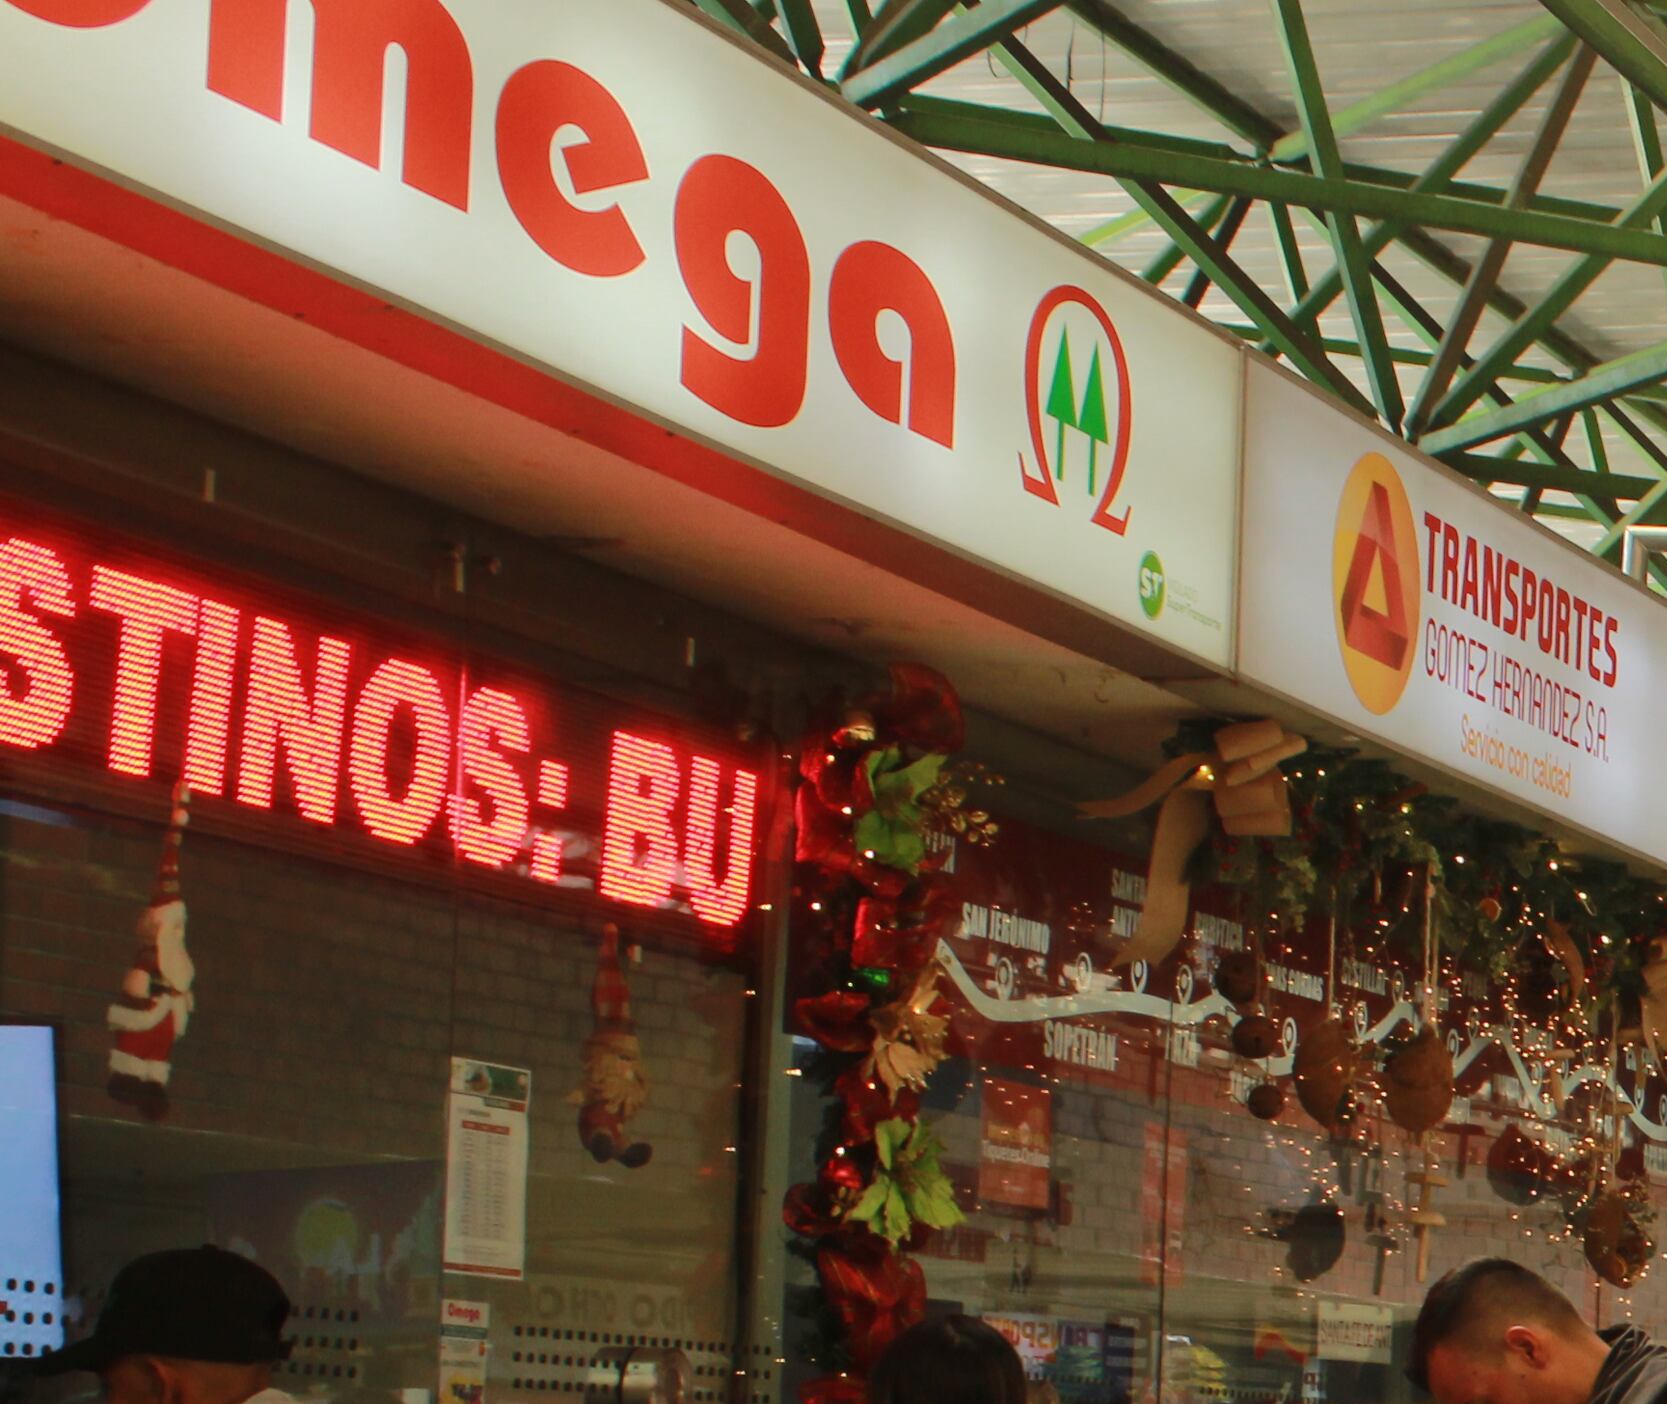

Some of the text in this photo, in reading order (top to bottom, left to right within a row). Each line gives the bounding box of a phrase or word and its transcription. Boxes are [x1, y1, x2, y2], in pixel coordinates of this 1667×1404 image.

[8, 0, 956, 452] mega
[1424, 511, 1619, 688] TRANSPORTES
[1425, 618, 1487, 703] GOMEZ
[1493, 653, 1582, 749] HERNANDEZ
[600, 730, 758, 927] BU
[1460, 713, 1572, 799] Servicio con calidad
